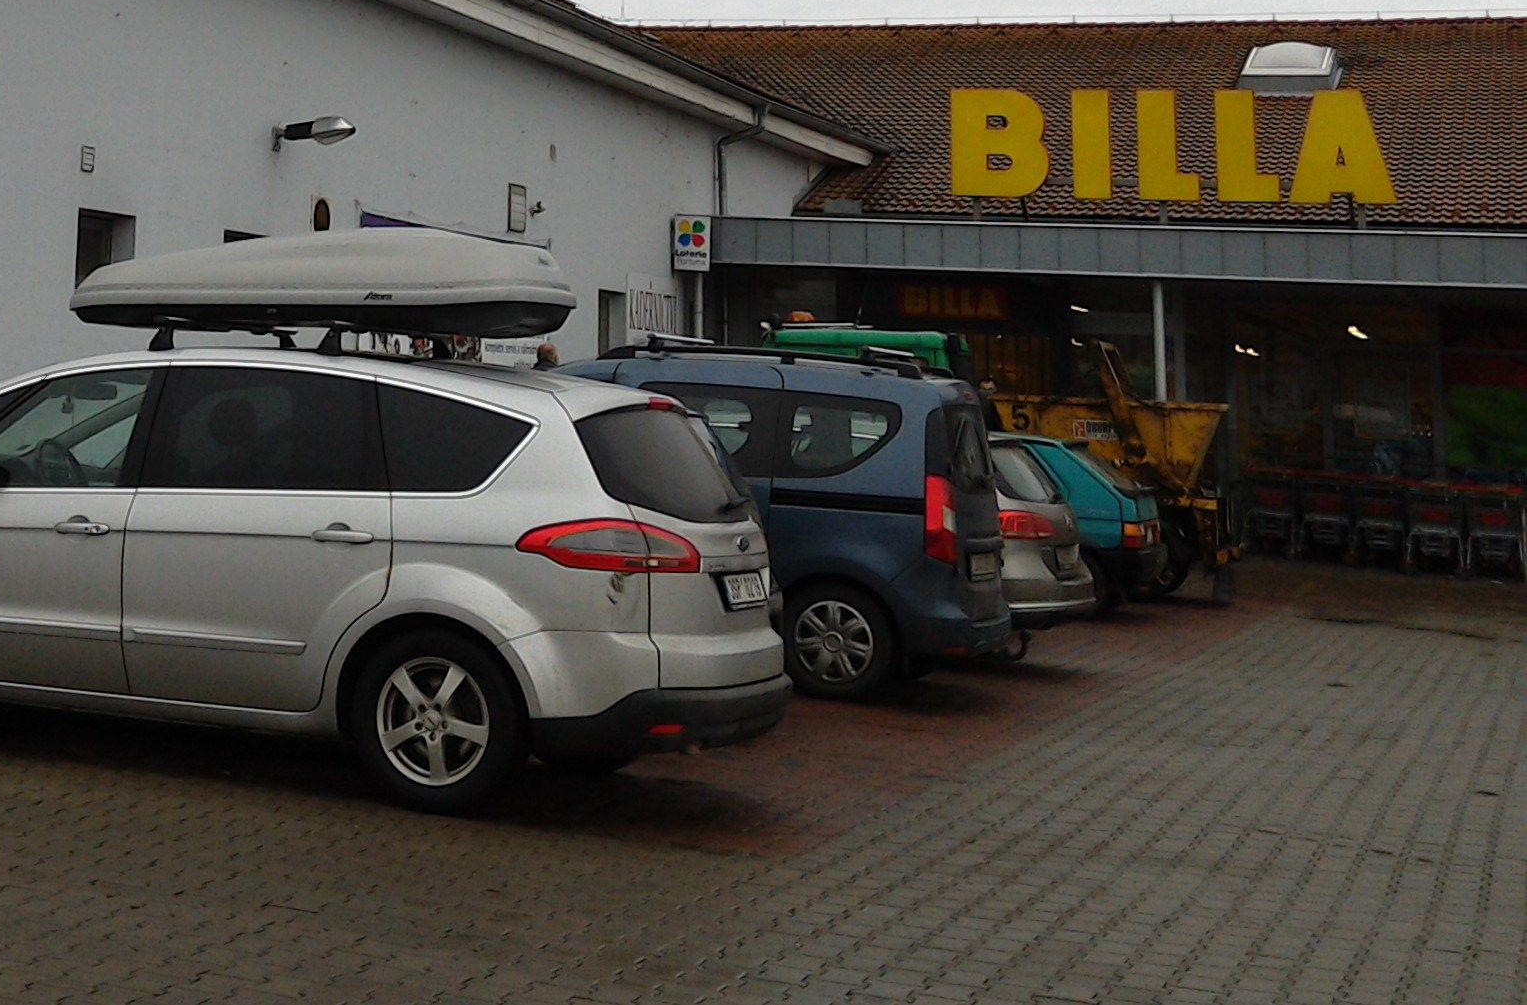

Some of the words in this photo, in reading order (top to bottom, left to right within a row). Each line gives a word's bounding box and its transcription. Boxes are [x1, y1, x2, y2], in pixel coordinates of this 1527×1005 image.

[949, 88, 1398, 205] BILLA
[675, 249, 708, 259] Loterie
[1011, 404, 1031, 430] 5
